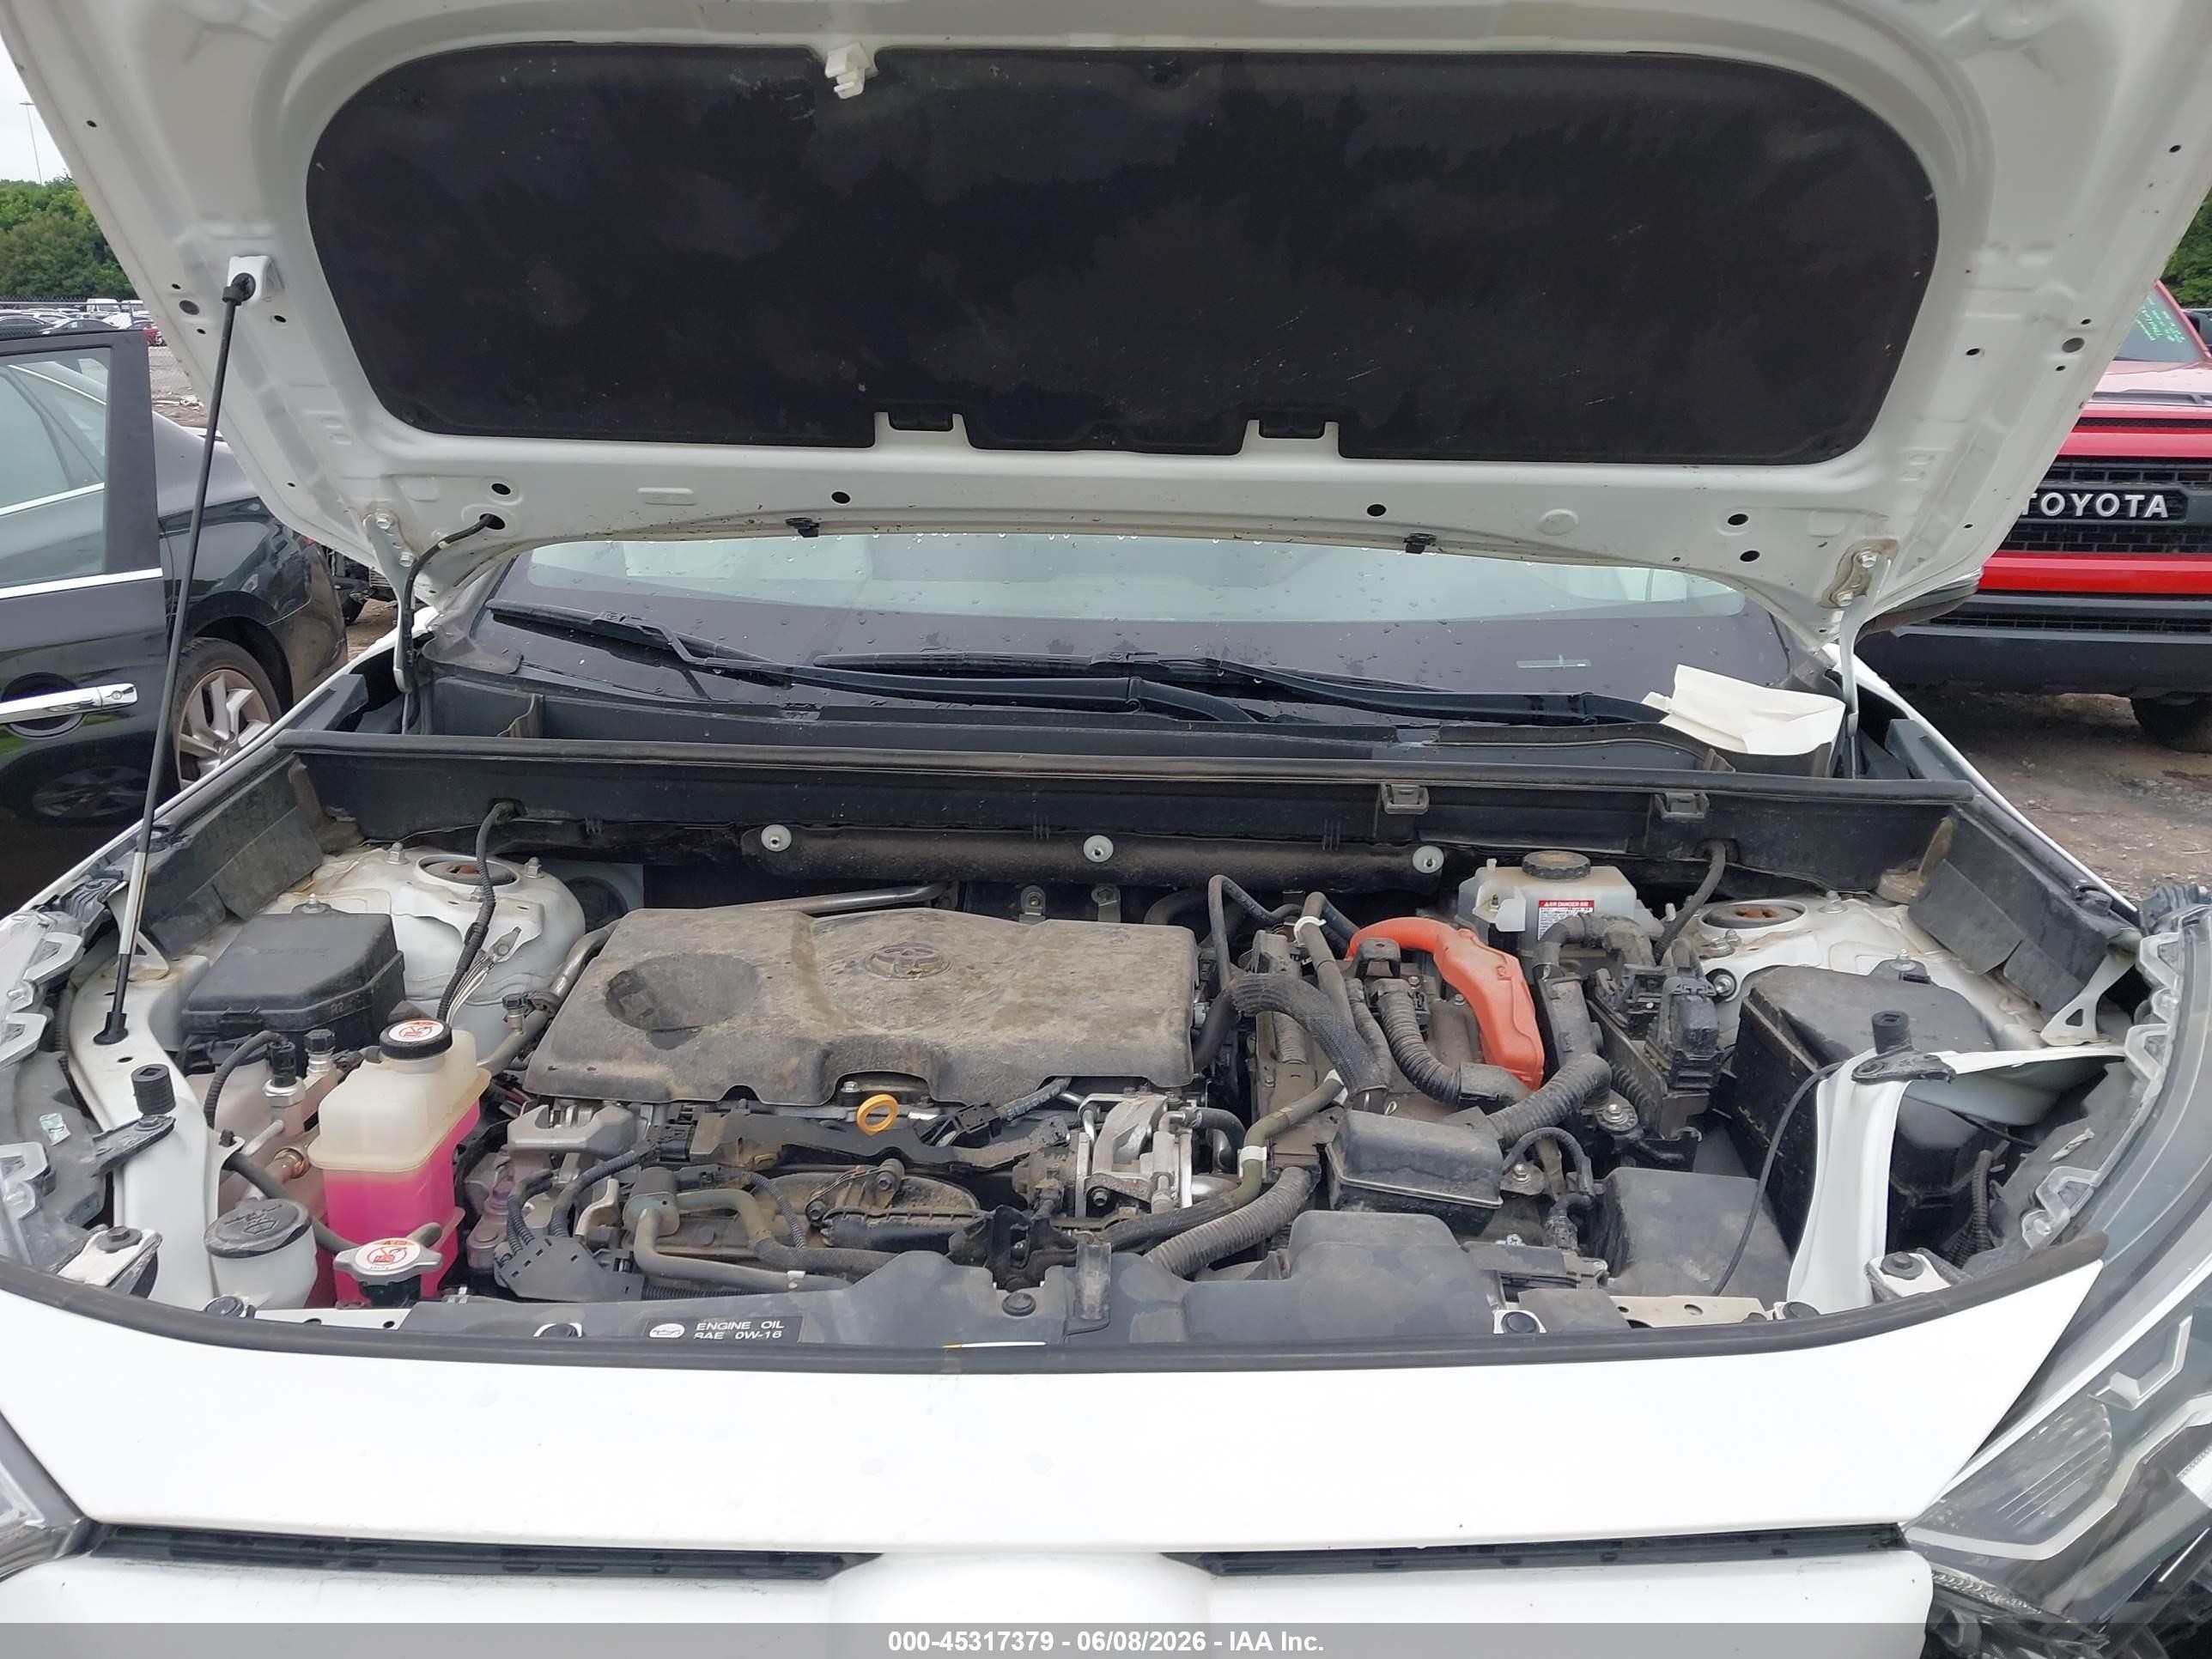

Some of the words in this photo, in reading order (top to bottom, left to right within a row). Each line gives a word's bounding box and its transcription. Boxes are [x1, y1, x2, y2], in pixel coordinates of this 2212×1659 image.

[696, 1321, 752, 1331] ENGINE
[761, 1320, 785, 1330] OIL
[693, 1331, 725, 1340] SAE
